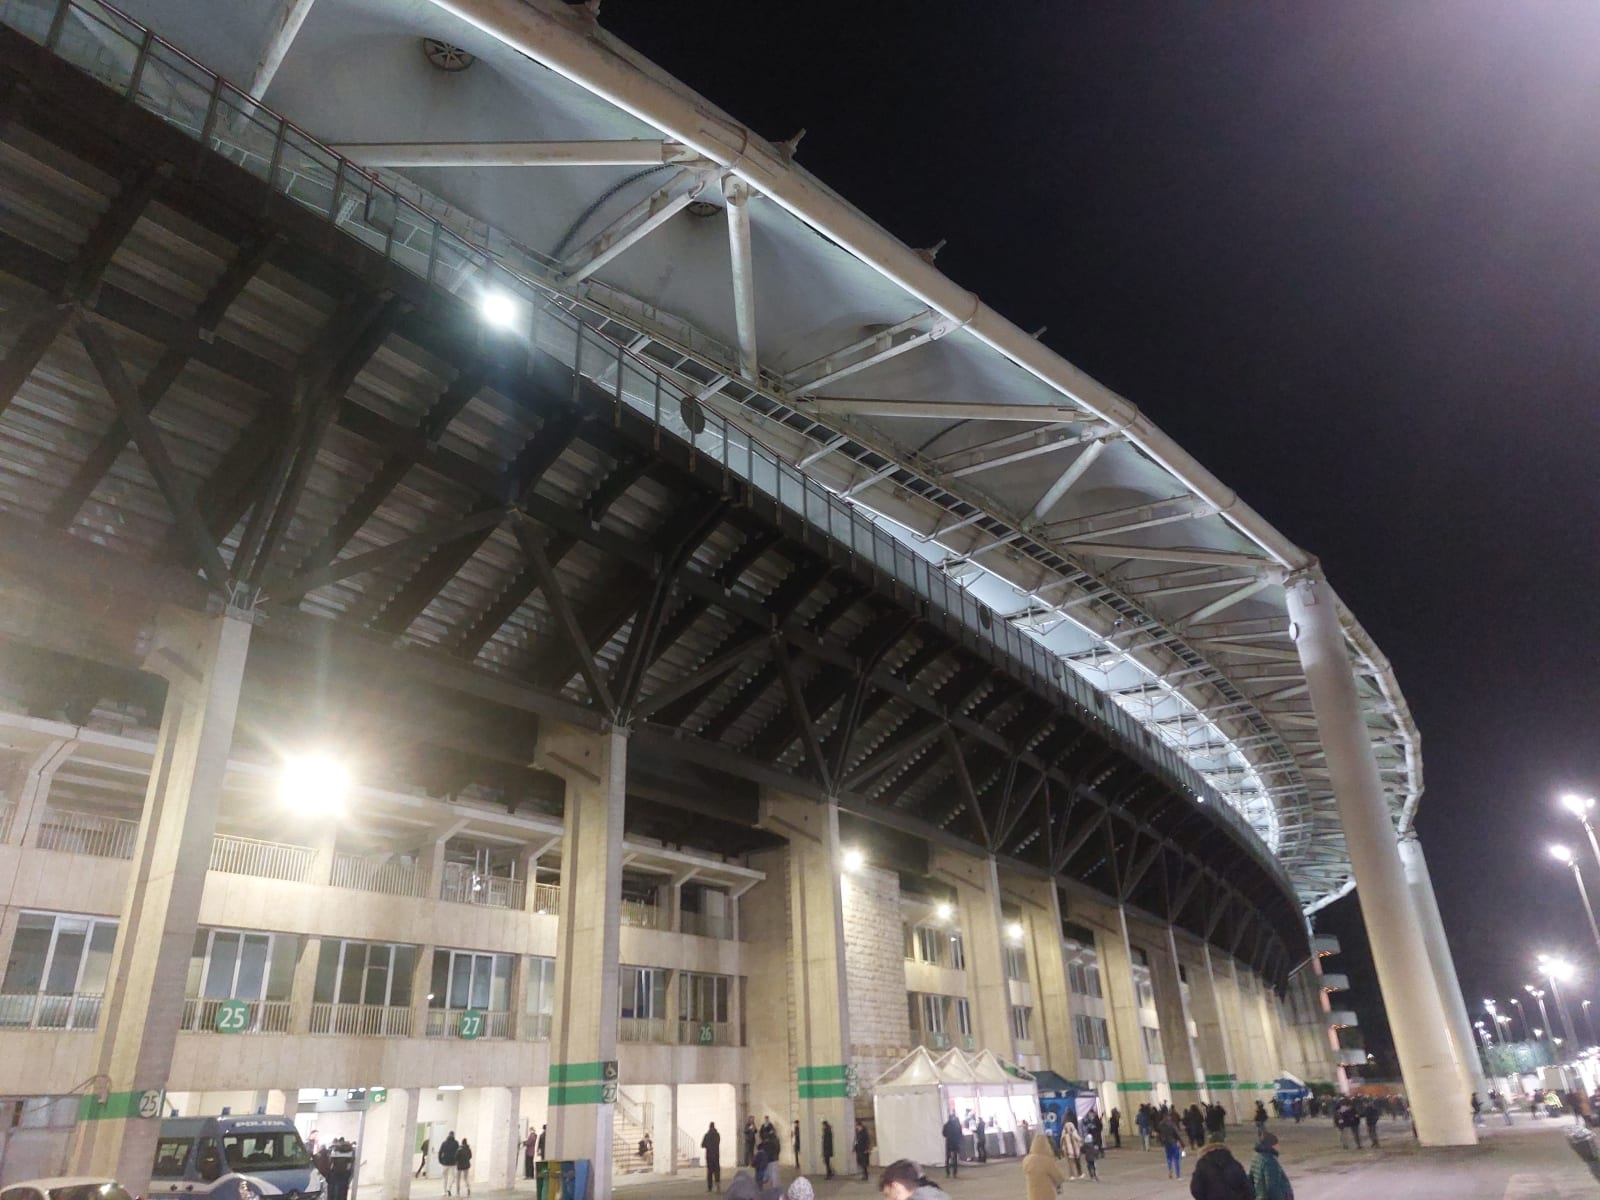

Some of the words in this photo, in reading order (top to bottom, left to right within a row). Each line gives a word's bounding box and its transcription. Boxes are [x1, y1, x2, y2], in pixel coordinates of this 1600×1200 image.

[220, 1007, 245, 1028] 25
[463, 1017, 480, 1035] 27
[700, 1026, 712, 1041] 26
[141, 1095, 157, 1112] 25
